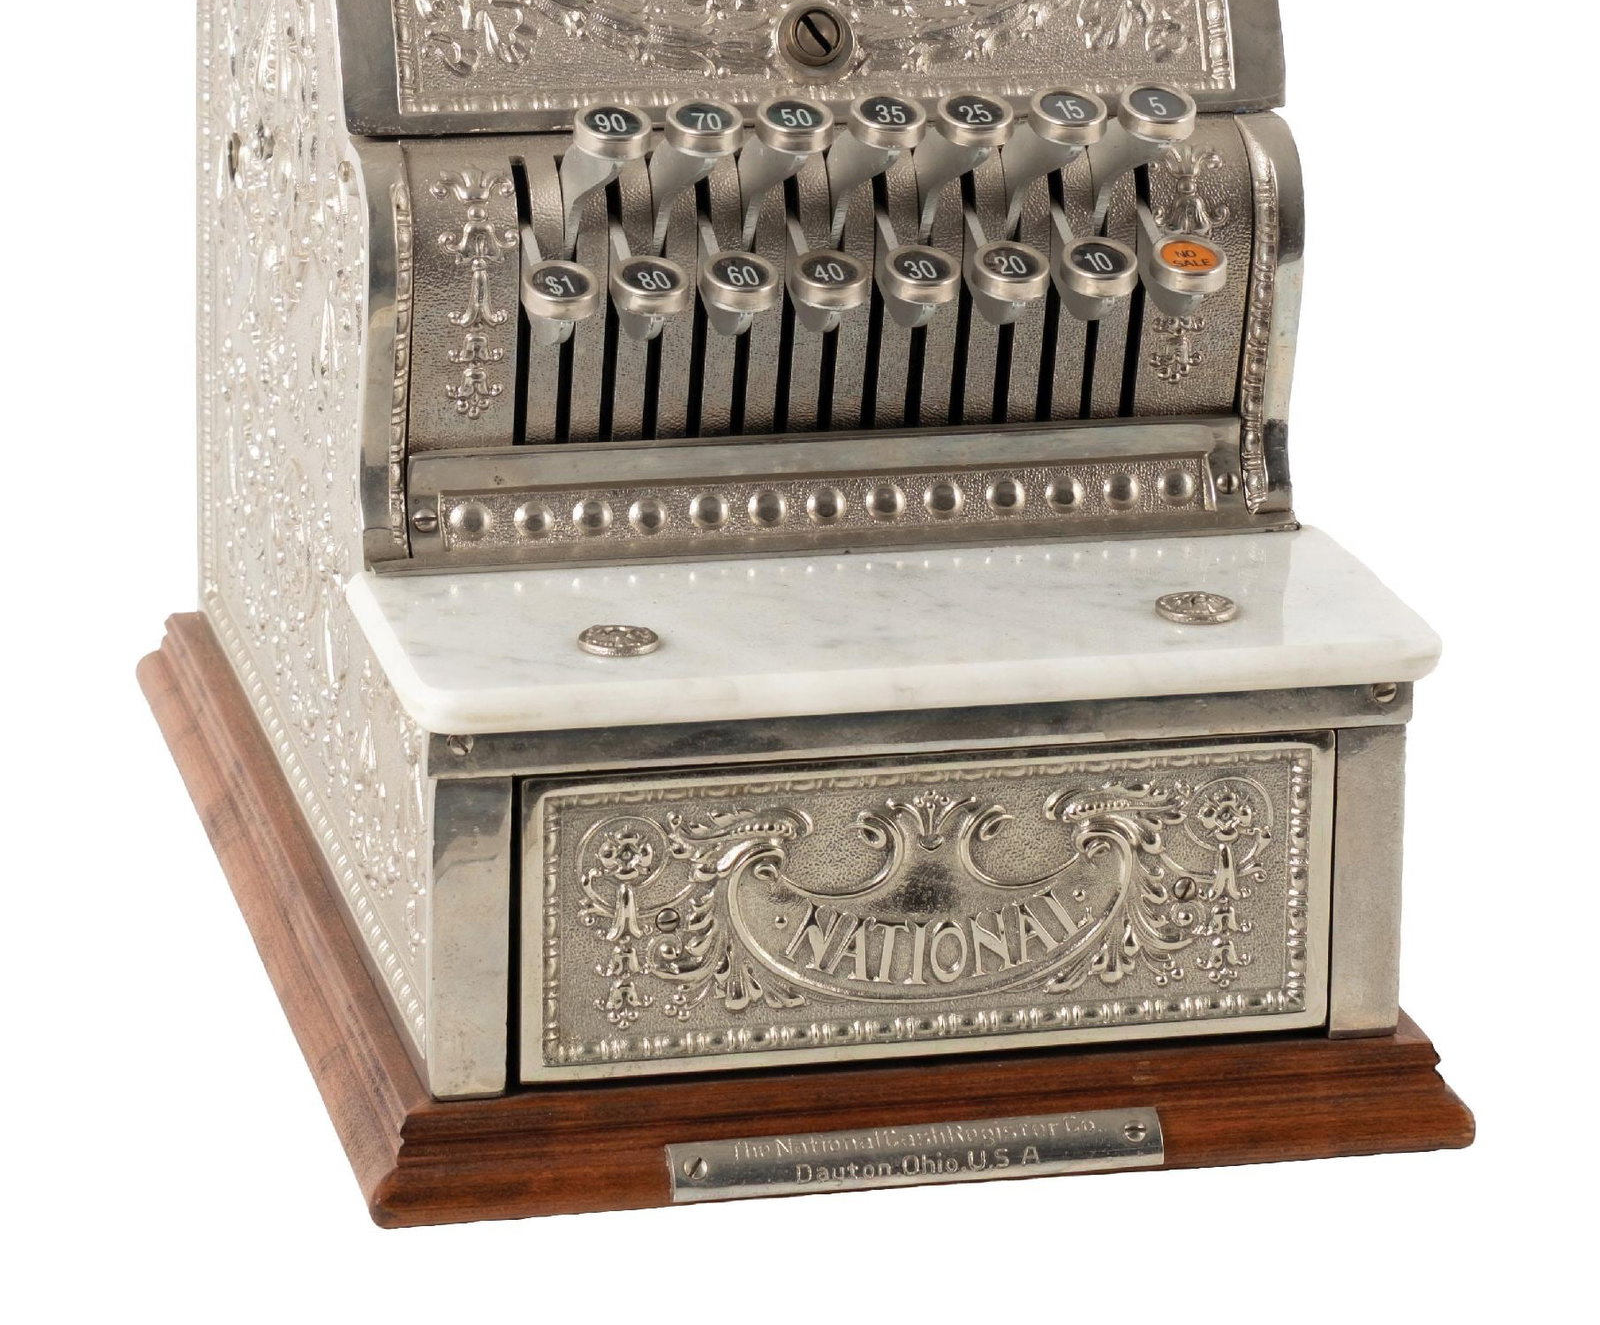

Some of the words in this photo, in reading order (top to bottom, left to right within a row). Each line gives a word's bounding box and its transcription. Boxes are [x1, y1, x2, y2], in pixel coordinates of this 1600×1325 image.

[875, 104, 906, 125] 35
[958, 104, 993, 124] 25
[1055, 100, 1085, 120] 15
[1148, 96, 1168, 116] 5
[593, 113, 627, 133] 90
[690, 111, 722, 131] 70
[780, 108, 813, 127] 50
[1084, 252, 1113, 272] 10
[1172, 258, 1213, 268] SALE
[1174, 249, 1197, 258] NO
[814, 262, 845, 282] 40
[903, 259, 937, 280] 30
[993, 255, 1027, 276] 20
[545, 275, 575, 297] $1
[637, 270, 672, 291] 80
[727, 265, 760, 287] 60
[784, 889, 1094, 985] NATIONAL
[734, 1140, 770, 1161] The
[775, 1129, 881, 1158] National
[883, 1125, 946, 1148] Cash
[948, 1121, 1059, 1147] Register
